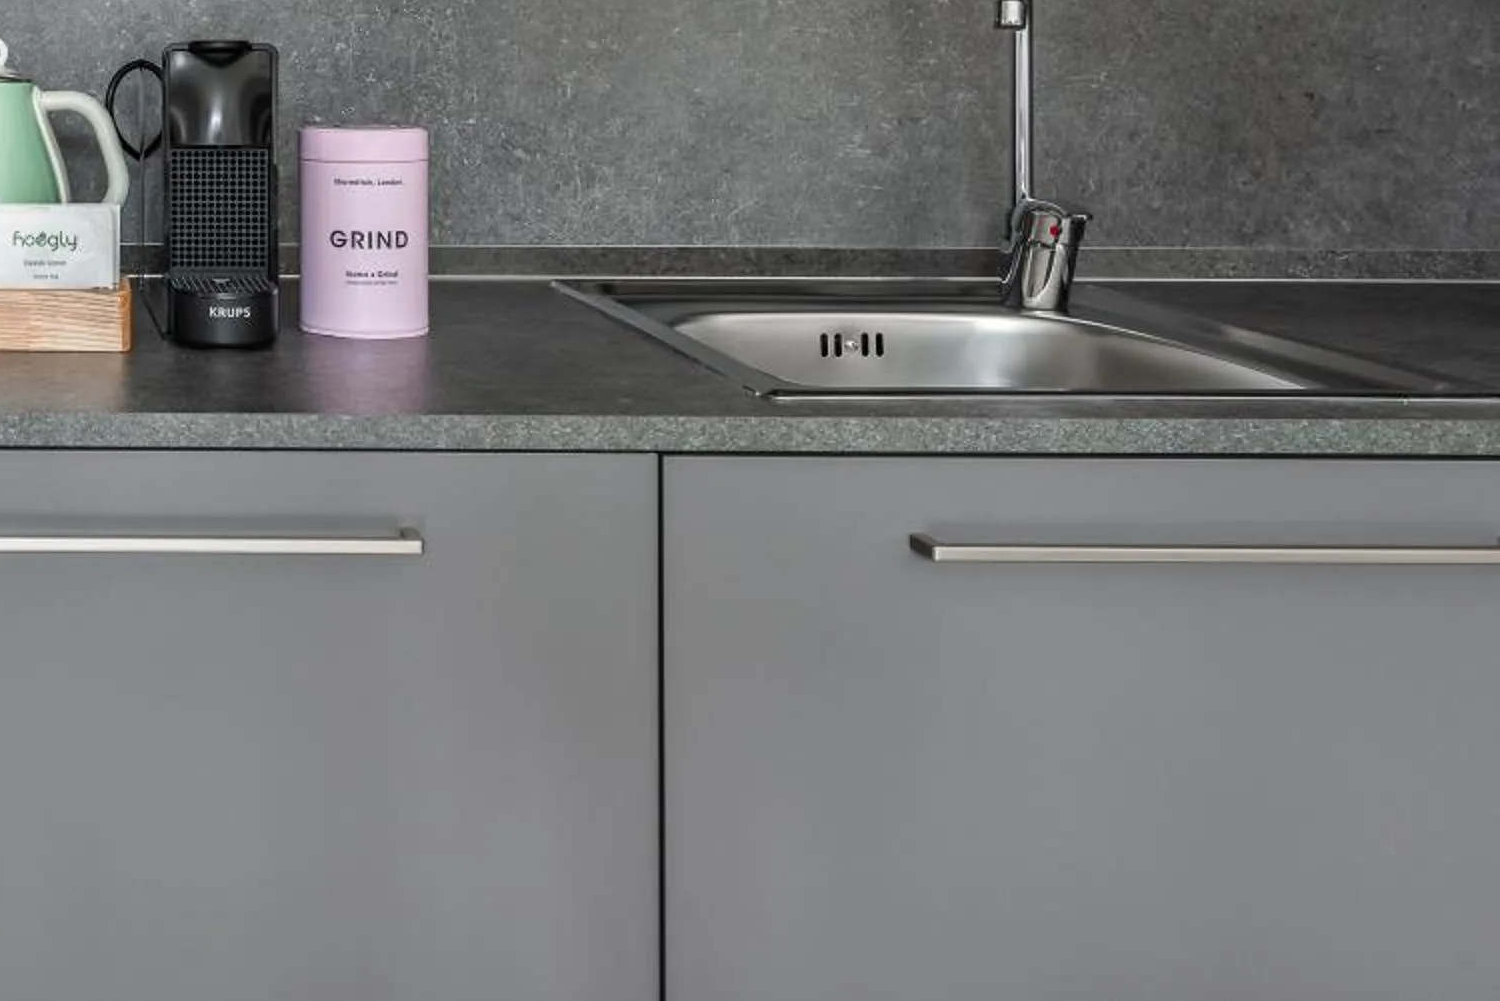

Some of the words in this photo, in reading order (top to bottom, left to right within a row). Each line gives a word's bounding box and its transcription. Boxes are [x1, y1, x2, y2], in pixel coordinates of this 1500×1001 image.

[12, 230, 78, 252] hoogly
[329, 230, 409, 249] GRIND
[209, 306, 251, 318] KRUPS
